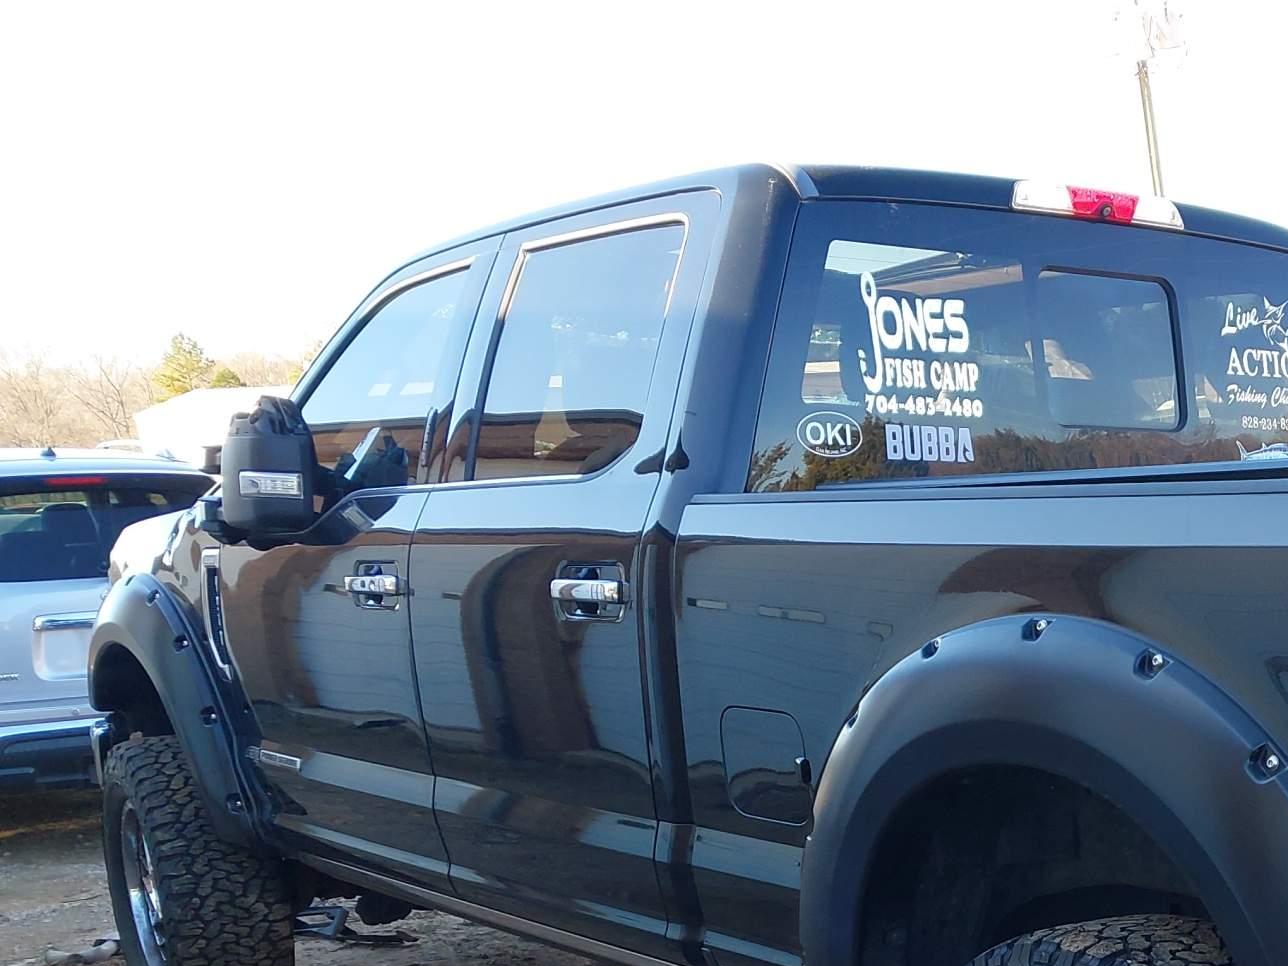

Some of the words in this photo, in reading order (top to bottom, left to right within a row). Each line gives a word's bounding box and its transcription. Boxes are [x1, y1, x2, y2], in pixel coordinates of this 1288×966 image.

[858, 271, 970, 393] JONES
[1221, 301, 1259, 336] Live
[884, 357, 927, 389] FISH
[930, 360, 979, 392] CAMP
[1226, 383, 1268, 409] Fishing
[805, 421, 852, 446] OKI
[885, 423, 974, 463] BUBBA
